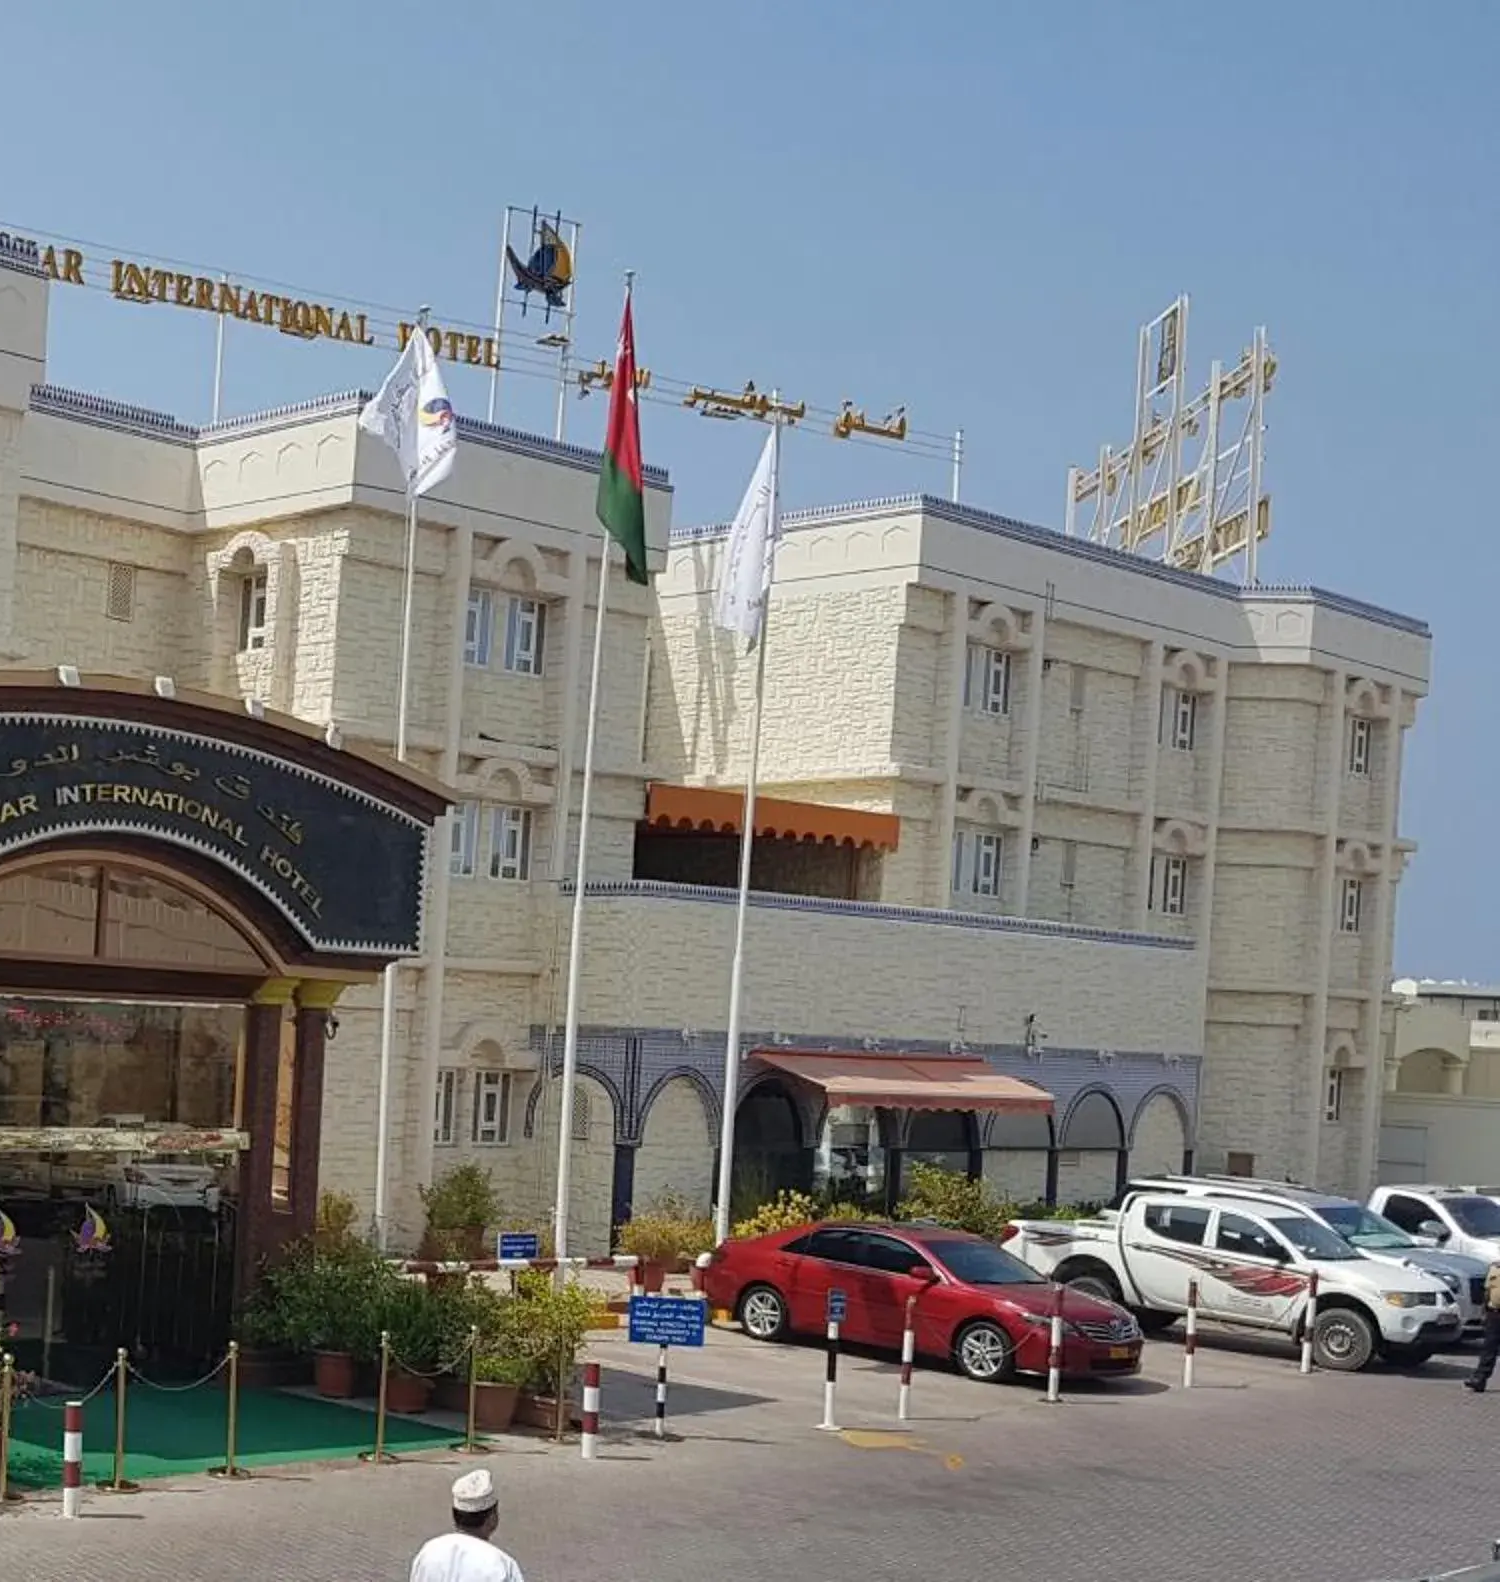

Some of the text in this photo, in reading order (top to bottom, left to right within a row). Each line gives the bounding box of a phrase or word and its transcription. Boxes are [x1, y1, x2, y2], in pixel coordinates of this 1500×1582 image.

[111, 259, 375, 345] INTERNATIONAL
[100, 745, 200, 782] بوشر
[214, 774, 305, 845] فندق
[56, 783, 249, 847] INTERNATIONAL
[260, 845, 322, 919] HOTEL
